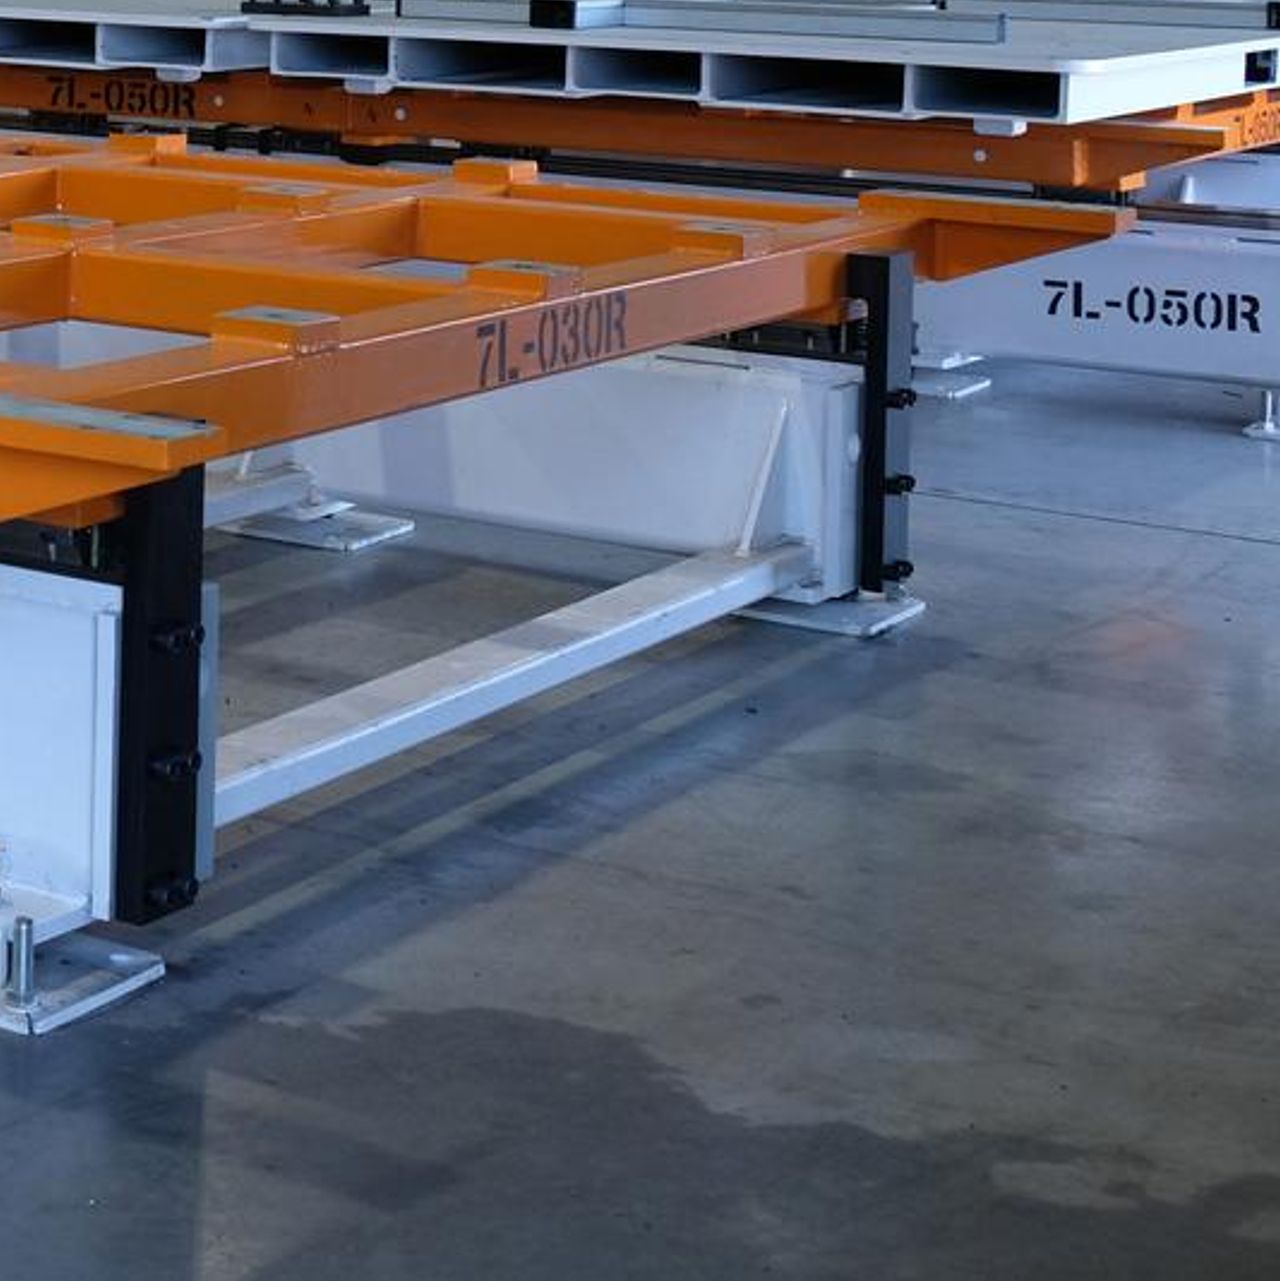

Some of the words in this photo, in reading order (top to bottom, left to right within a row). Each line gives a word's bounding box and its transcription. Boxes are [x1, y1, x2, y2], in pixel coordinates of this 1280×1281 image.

[46, 74, 196, 120] 7L-050R
[1042, 279, 1262, 334] 7L-050R
[475, 289, 628, 390] 7L-030R
